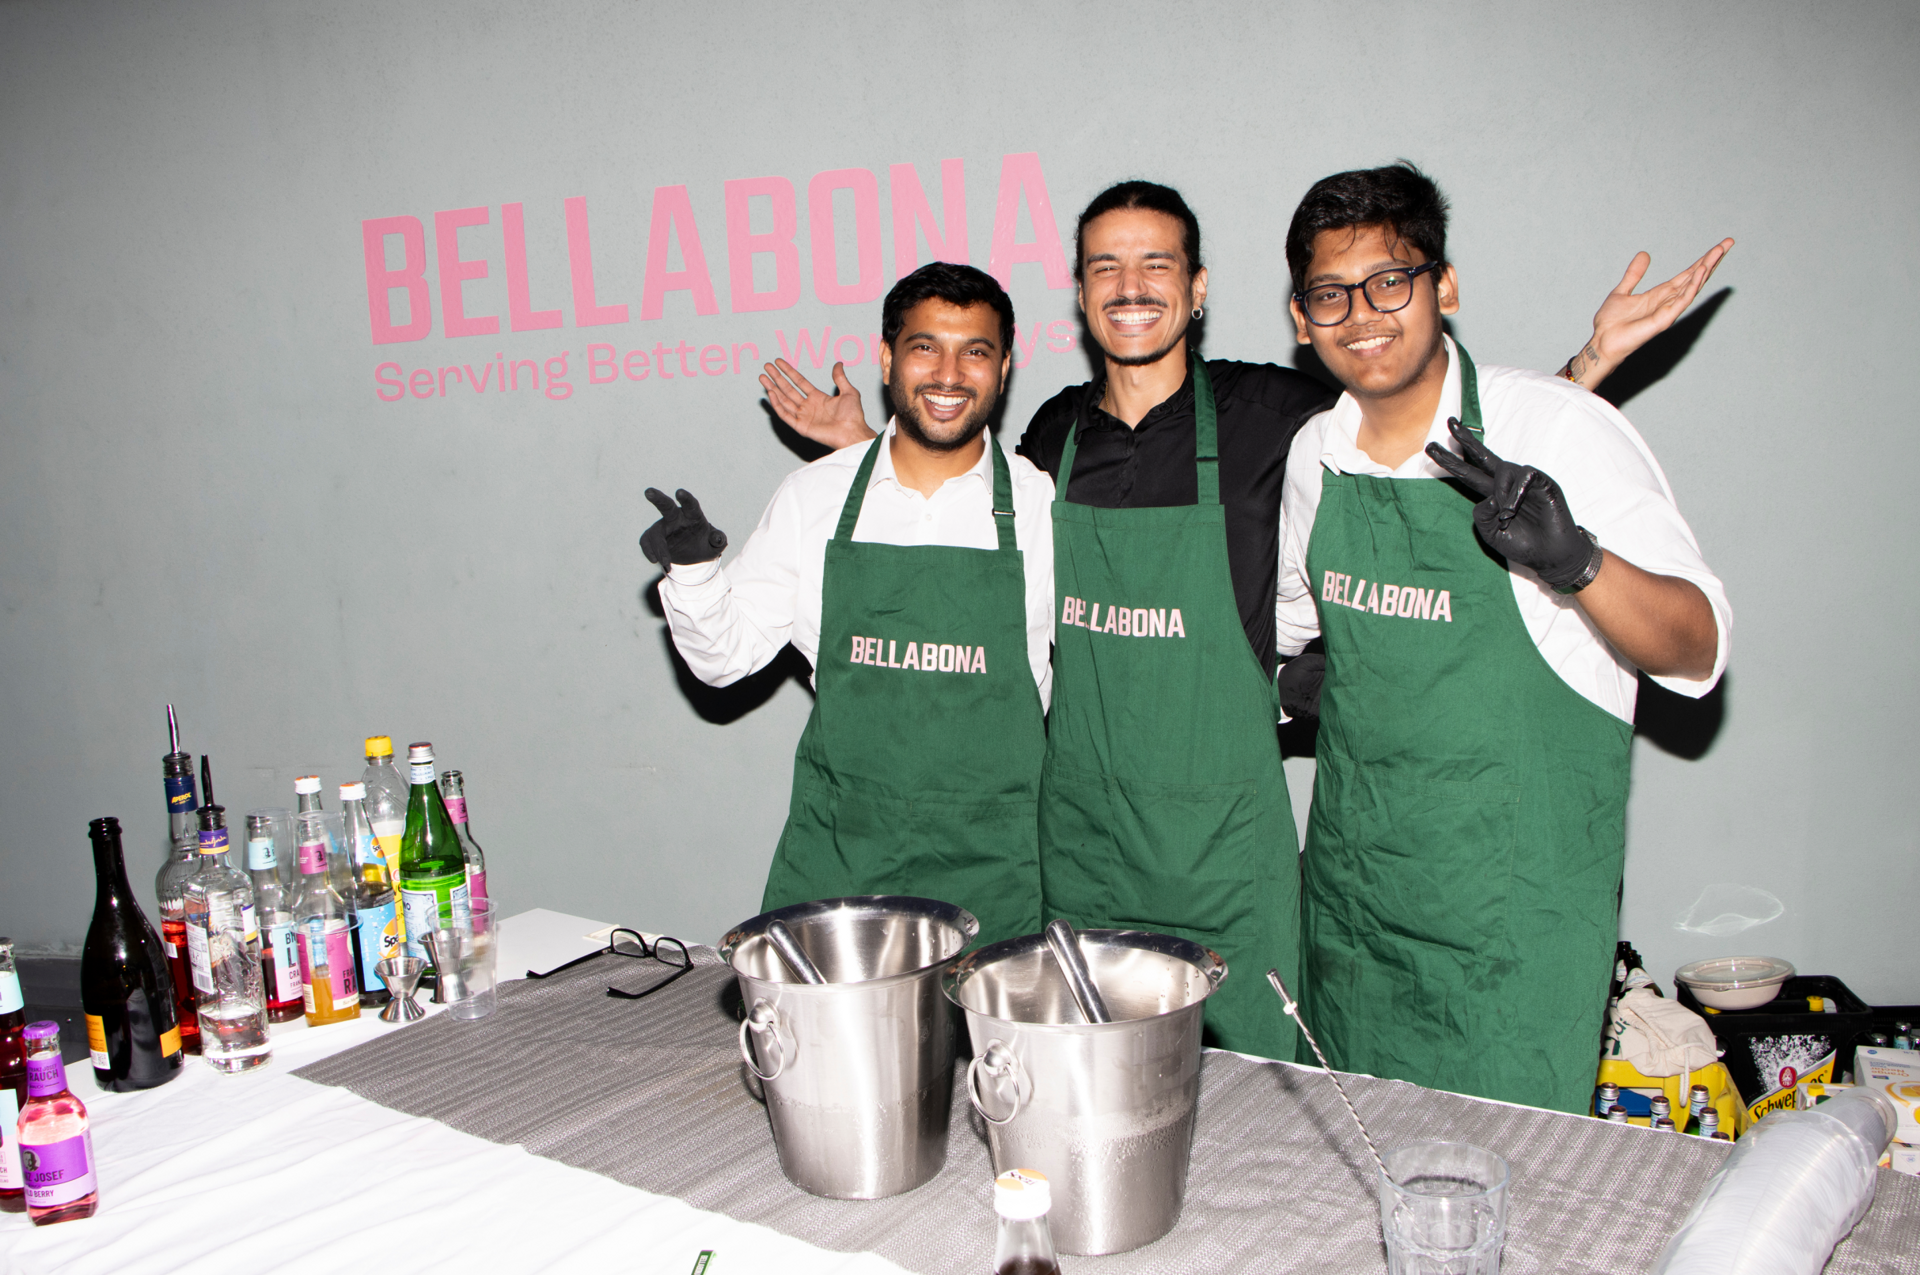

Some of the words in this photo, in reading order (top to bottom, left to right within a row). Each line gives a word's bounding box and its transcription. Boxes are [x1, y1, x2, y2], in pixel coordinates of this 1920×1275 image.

[362, 152, 1073, 345] BELLABONA
[374, 351, 574, 402] Serving
[586, 340, 760, 385] Better
[774, 319, 1077, 369] Worys
[1322, 570, 1452, 622] BELLABONA
[1061, 596, 1186, 638] BELLABONA
[850, 635, 987, 674] BELLABONA
[28, 1069, 59, 1082] RAUCH
[34, 1169, 64, 1182] JOSEF
[34, 1190, 54, 1198] BERRY
